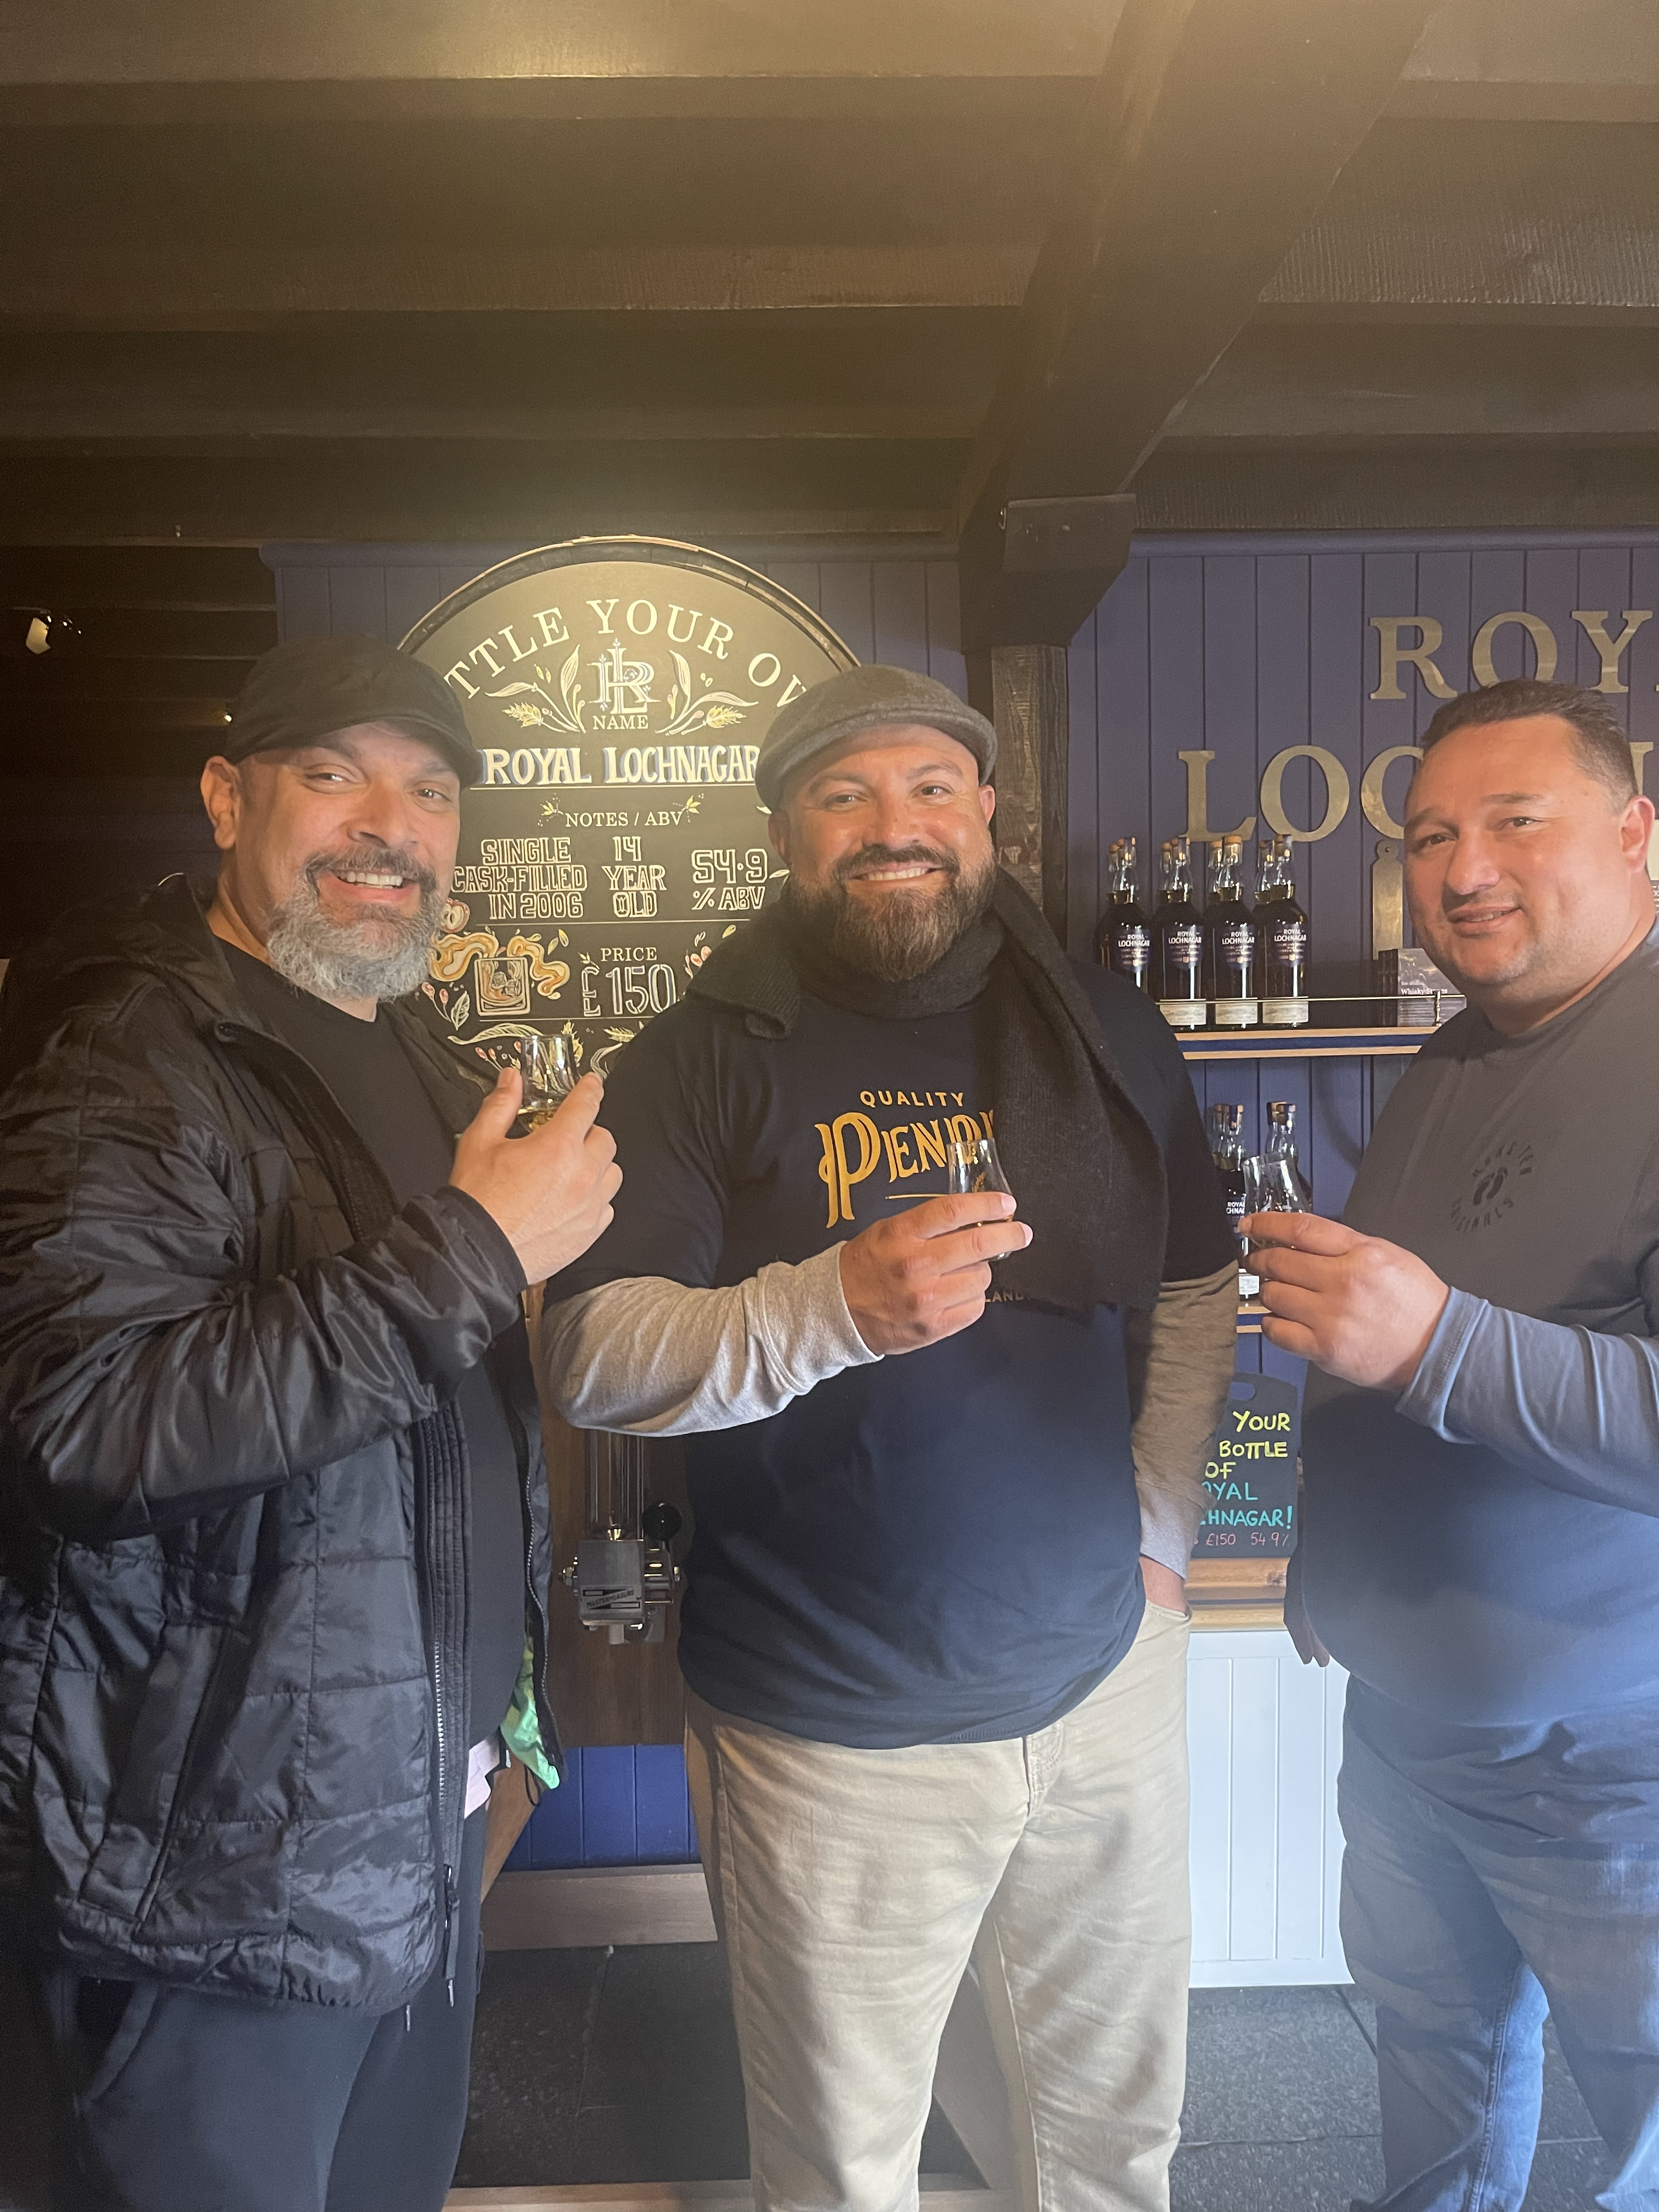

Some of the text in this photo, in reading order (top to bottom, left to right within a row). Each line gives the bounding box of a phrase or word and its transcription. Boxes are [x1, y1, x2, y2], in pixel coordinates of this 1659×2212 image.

[586, 599, 734, 659] YOUR
[1370, 610, 1659, 700] ROY
[592, 715, 648, 730] NAME
[479, 744, 760, 785] ROYAL LOCHNAGAR
[565, 811, 682, 827] NOTES / ABV
[481, 837, 572, 865] SINGLE
[612, 836, 642, 861] 14
[451, 865, 588, 893] CASK-FILLED
[601, 865, 667, 891] YEAR
[488, 892, 584, 919] IN 2006
[613, 890, 658, 917] OLD
[691, 885, 766, 911] % ABV
[600, 947, 657, 962] PRICE
[580, 963, 678, 1017] £150
[860, 1091, 963, 1108] QUALITY
[1233, 1410, 1290, 1432] YOUR
[1219, 1441, 1288, 1459] BOTTLE
[1205, 1462, 1236, 1479] OF
[1200, 1505, 1293, 1530] HNAGAR!
[1206, 1533, 1237, 1546] £150
